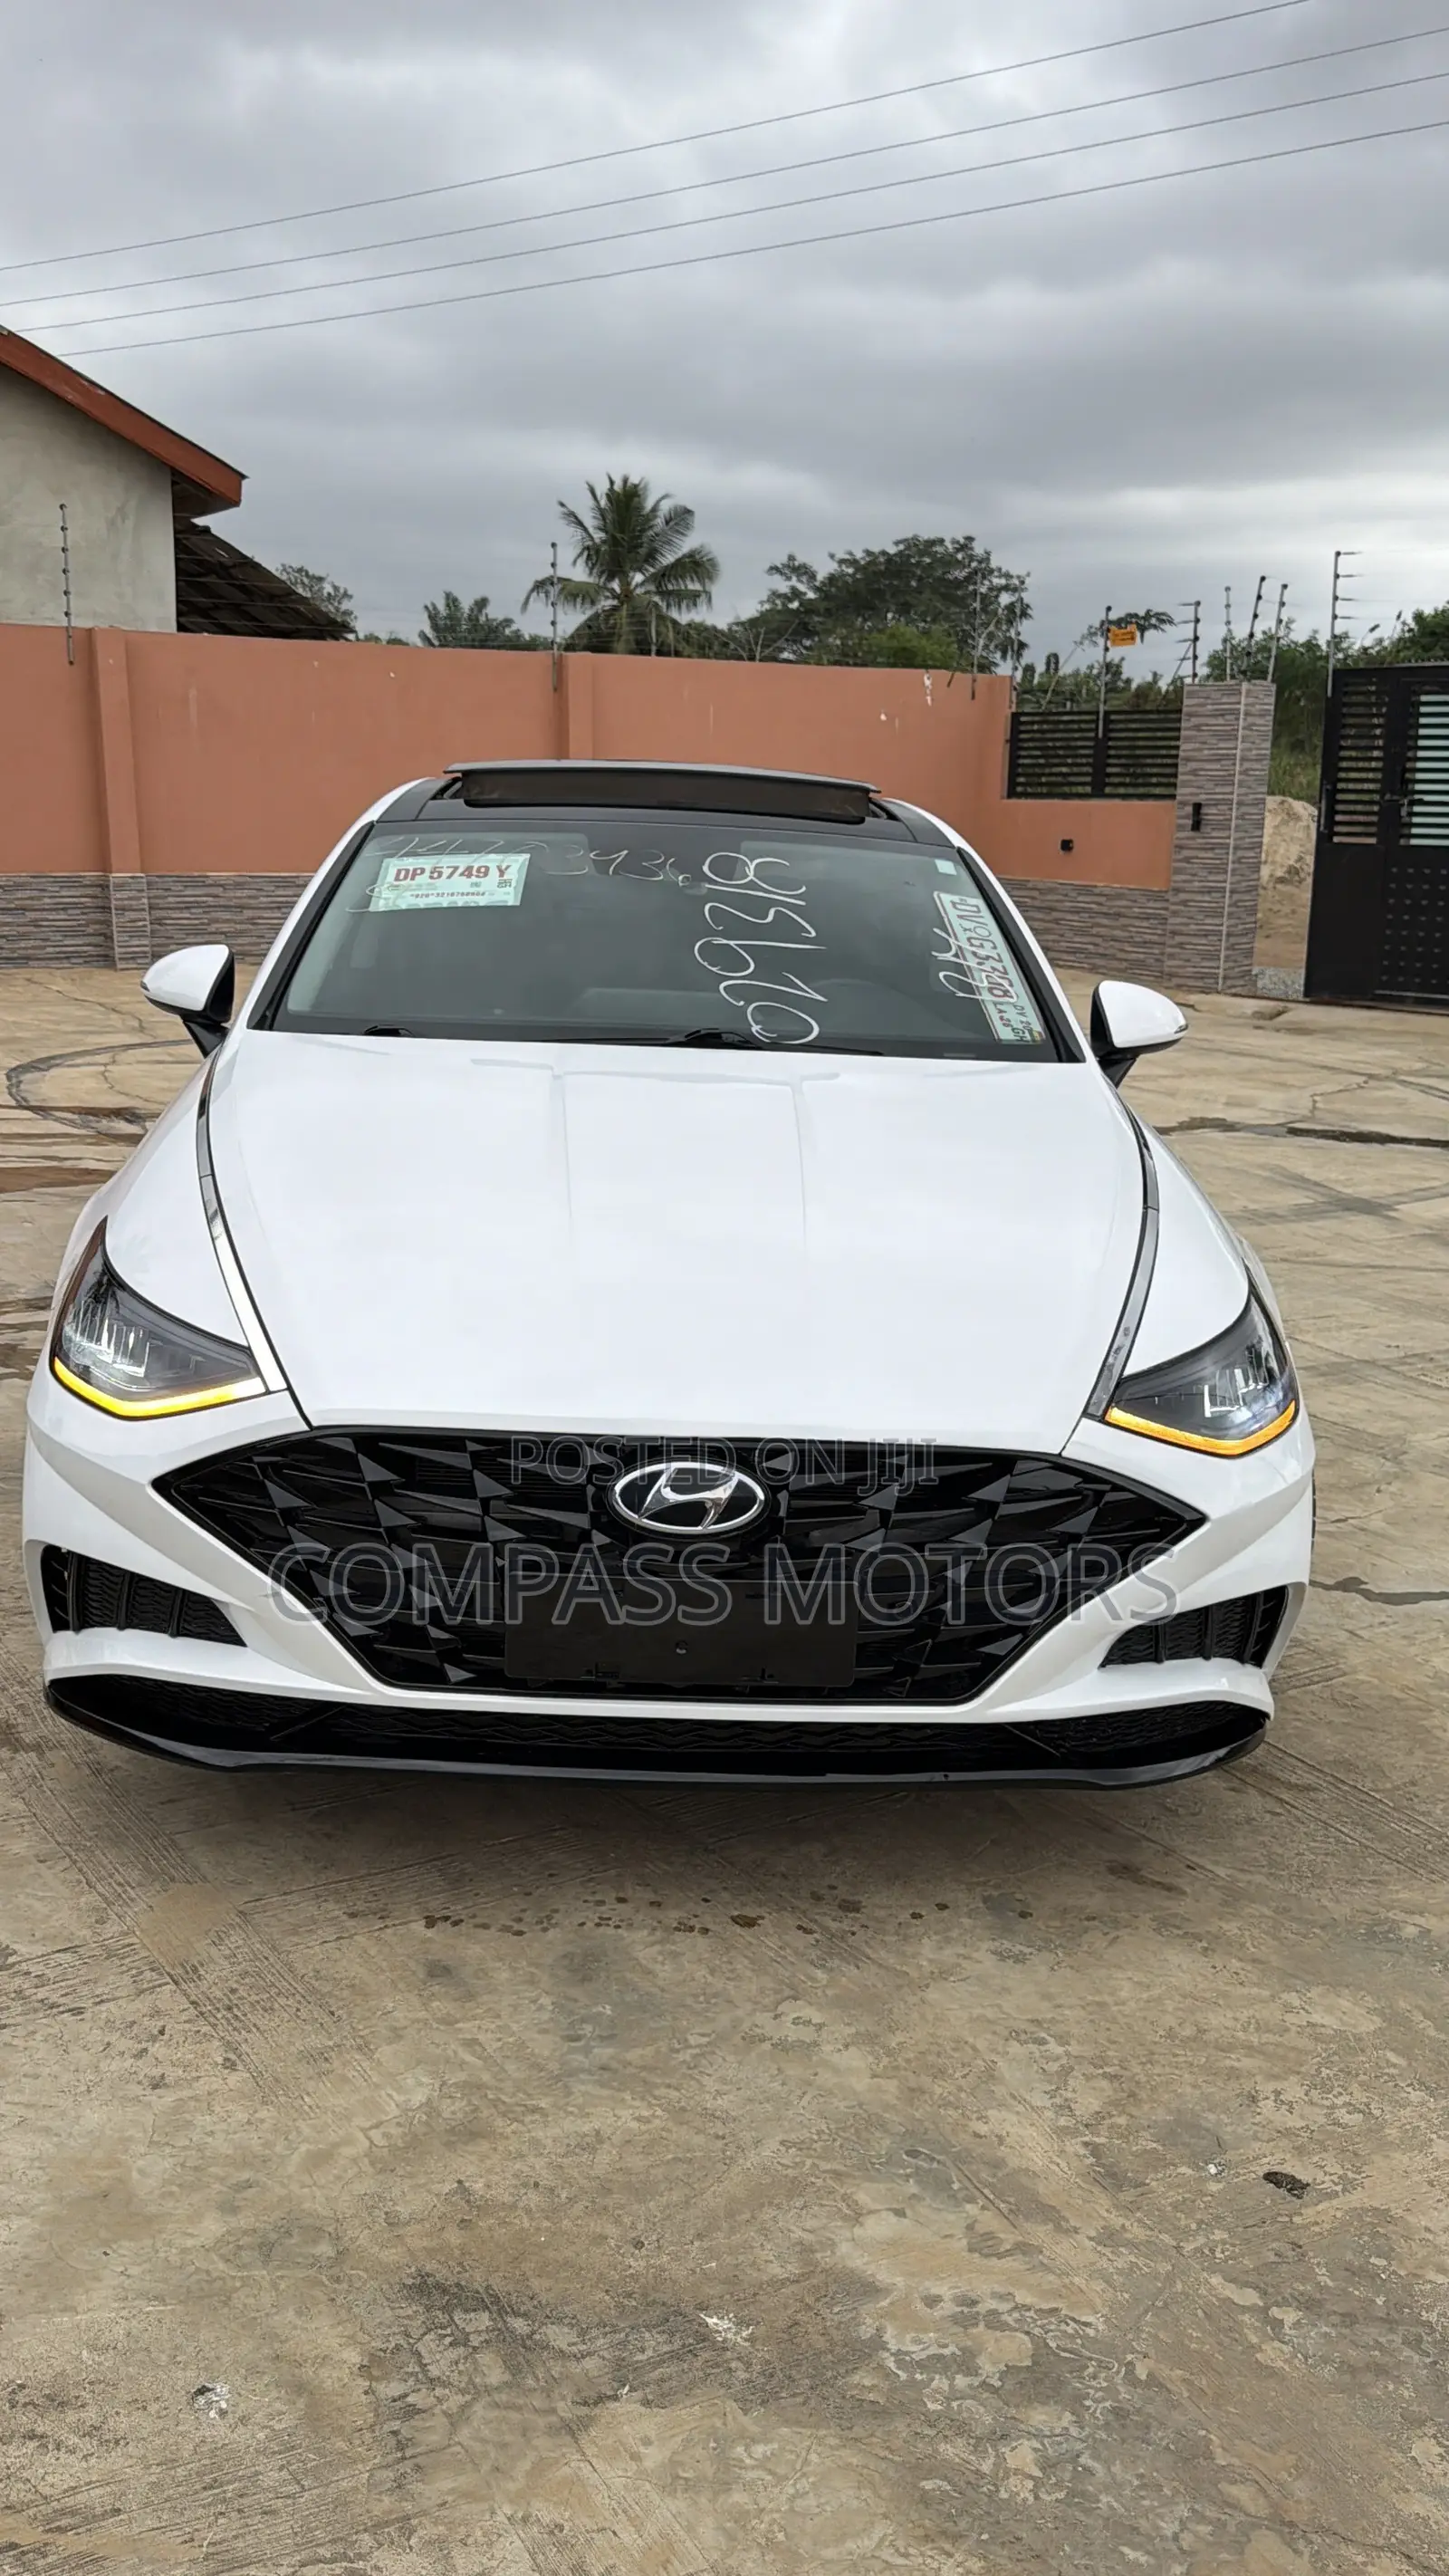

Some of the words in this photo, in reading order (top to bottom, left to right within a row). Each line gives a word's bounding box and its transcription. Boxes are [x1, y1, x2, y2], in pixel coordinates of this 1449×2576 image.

[393, 867, 426, 882] DP
[428, 865, 491, 880] 5749
[495, 864, 512, 879] Y
